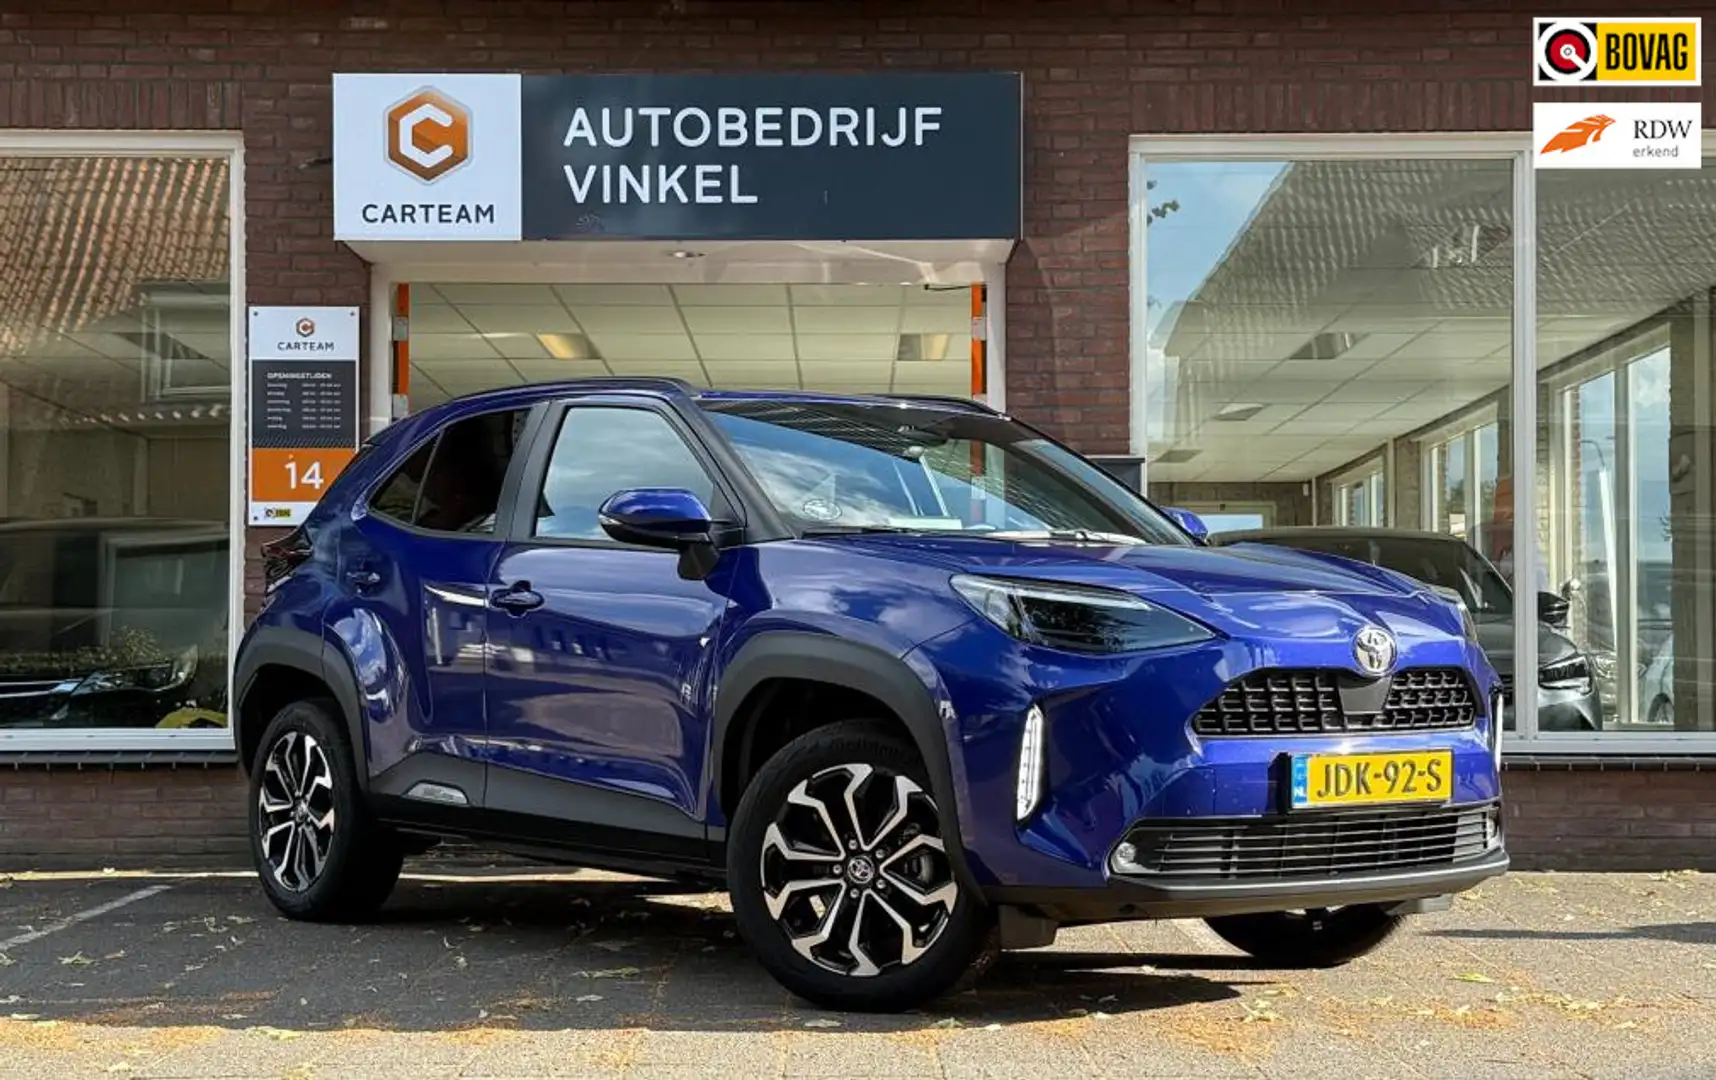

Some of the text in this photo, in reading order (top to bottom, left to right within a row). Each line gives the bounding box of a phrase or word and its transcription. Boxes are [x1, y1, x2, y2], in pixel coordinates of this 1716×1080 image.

[563, 107, 942, 148] AUTOBEDRIJF
[563, 164, 758, 204] VINKEL
[361, 203, 495, 224] CARTEAM
[277, 342, 335, 351] CARTEAM
[284, 461, 324, 490] 14
[1316, 758, 1442, 799] JDK-92-S
